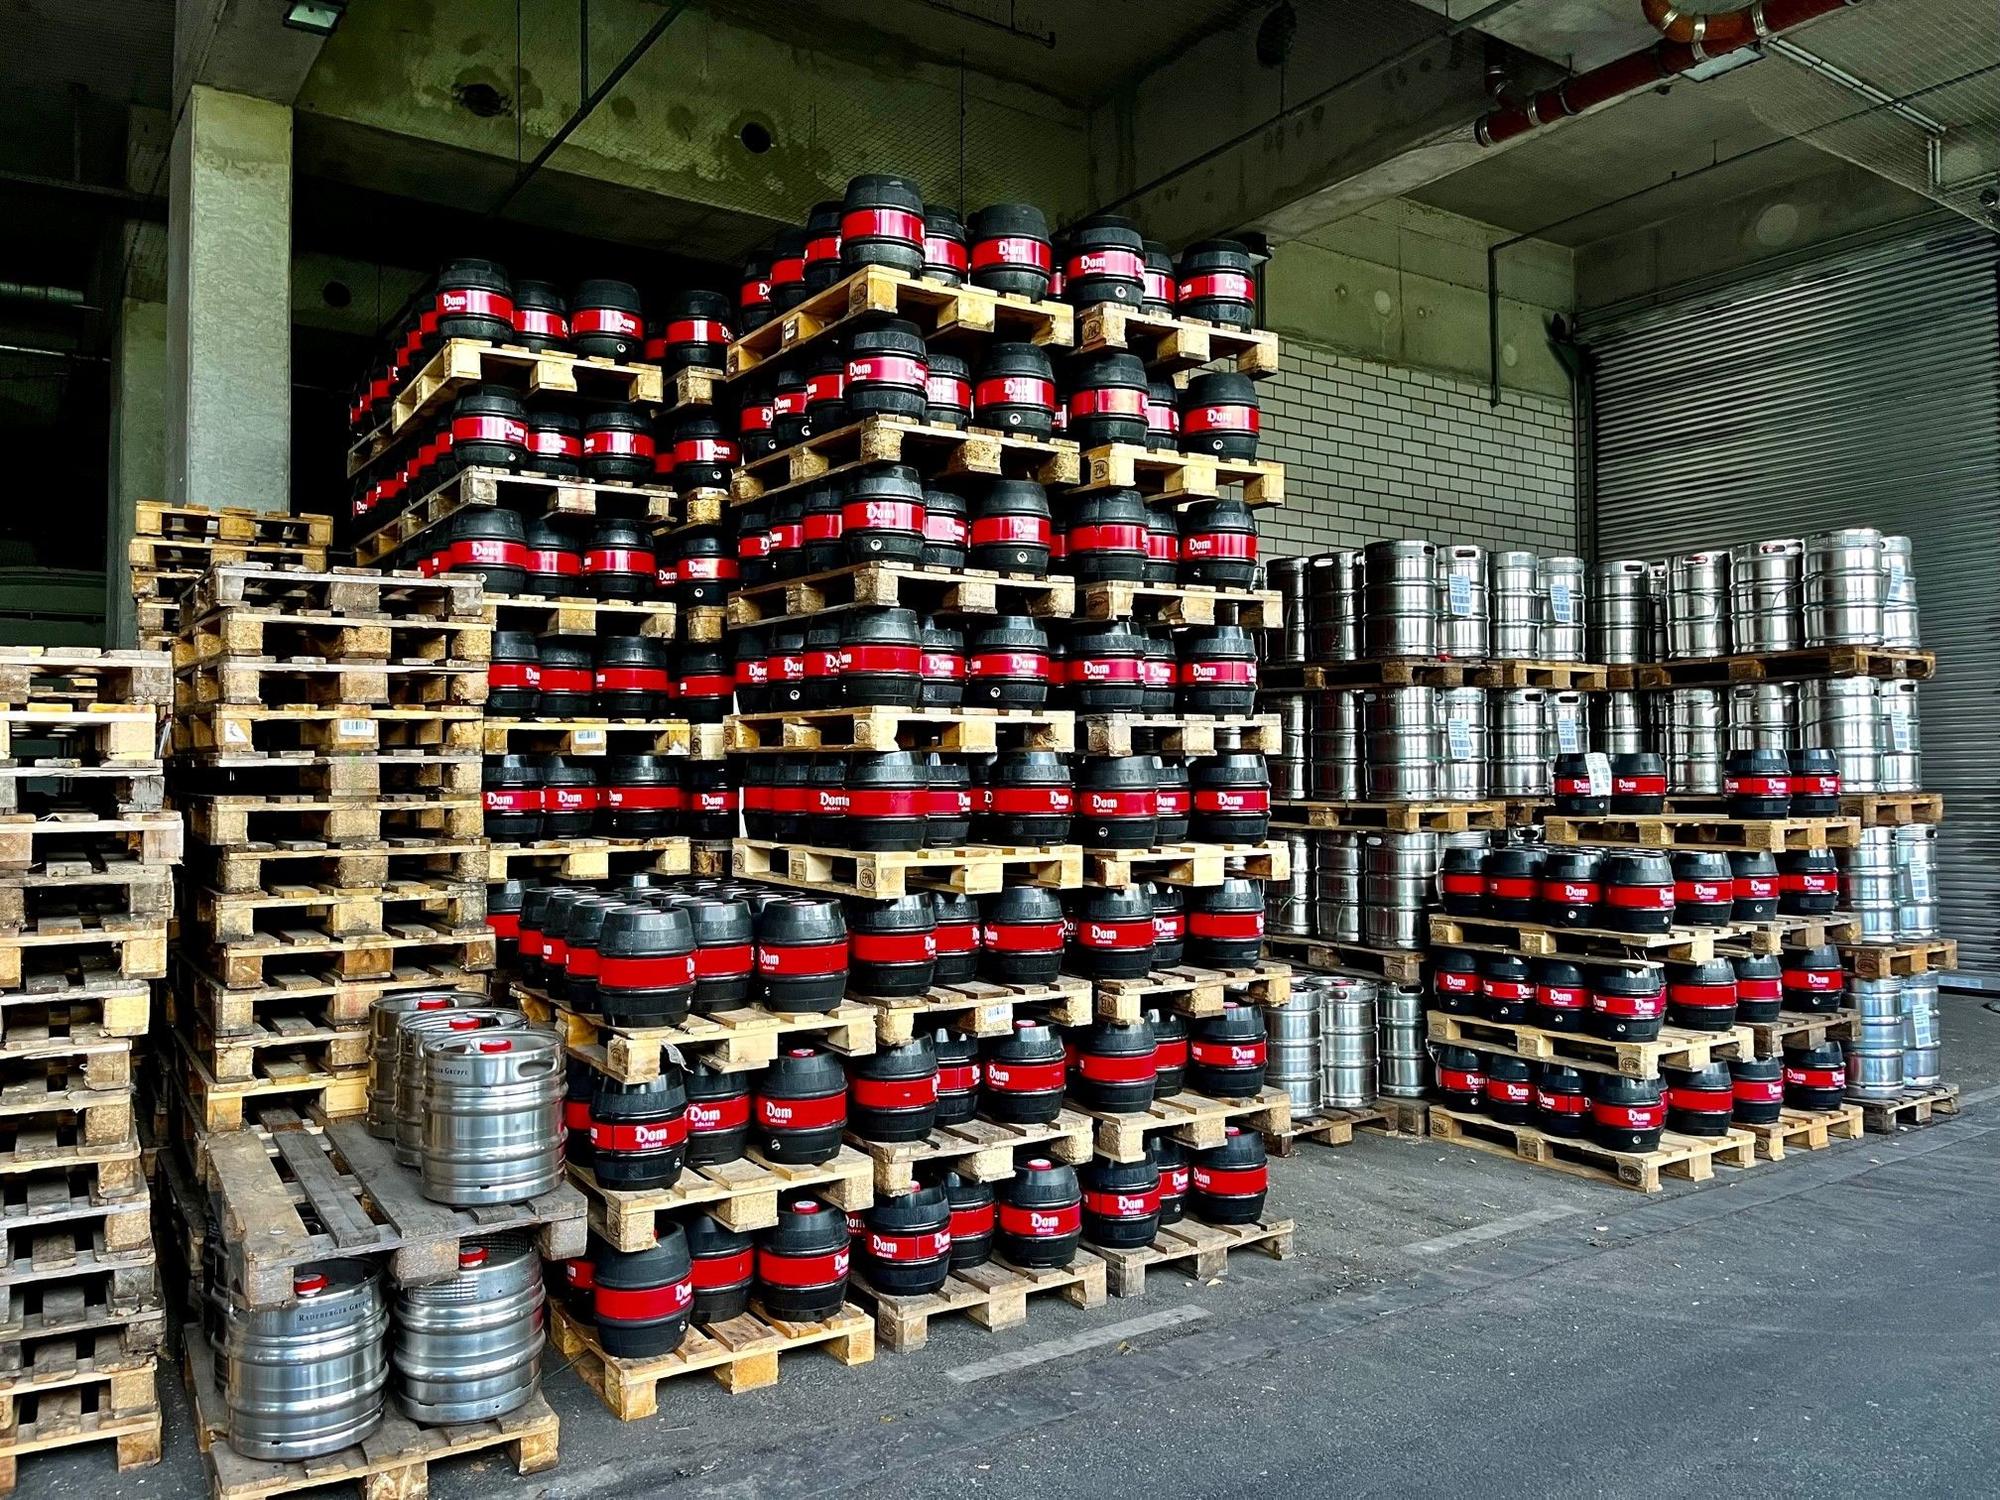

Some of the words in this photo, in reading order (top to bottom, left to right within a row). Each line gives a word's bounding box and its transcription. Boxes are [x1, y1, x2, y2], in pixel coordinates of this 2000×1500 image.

[998, 241, 1025, 257] Dom
[1081, 255, 1105, 270] Dom
[443, 294, 466, 307] Dom
[616, 314, 635, 329] Dom
[849, 362, 871, 377] Dom
[905, 364, 925, 380] Dom
[775, 398, 791, 412] Dom
[1207, 409, 1231, 423] Dom
[505, 422, 524, 438] Dom
[867, 503, 894, 520] Dom
[1014, 521, 1039, 536] Dom
[472, 543, 500, 556] Dom
[1189, 538, 1211, 551] Dom
[688, 561, 712, 573] Dom
[659, 569, 677, 580] Dom
[929, 656, 954, 671] Dom
[1011, 656, 1038, 671] Dom
[1084, 662, 1111, 677] Dom
[1150, 663, 1171, 677] Dom
[1192, 664, 1217, 678] Dom
[1619, 779, 1636, 789] Dom
[1768, 778, 1786, 790] Dom
[1819, 777, 1836, 789] Dom
[487, 791, 513, 805] Dom
[558, 791, 582, 802] Dom
[701, 793, 724, 805] Dom
[820, 792, 843, 806] Dom
[1049, 791, 1069, 805] Dom
[1092, 795, 1117, 808] Dom
[1217, 792, 1243, 806] Dom
[1751, 880, 1771, 892] Dom
[1804, 876, 1825, 887] Dom
[1565, 885, 1588, 897] Dom
[1694, 884, 1717, 896] Dom
[1156, 918, 1177, 932] Dom
[1091, 925, 1117, 940] Dom
[760, 948, 779, 965] Dom
[1447, 975, 1466, 987] Dom
[1808, 973, 1830, 984] Dom
[1550, 989, 1572, 1002] Dom
[1634, 999, 1656, 1011] Dom
[1232, 1046, 1255, 1061] Dom
[989, 1064, 1009, 1082] Dom
[1466, 1074, 1486, 1086] Dom
[1787, 1069, 1806, 1081] Dom
[1507, 1085, 1529, 1097] Dom
[1539, 1091, 1555, 1106] Dom
[690, 1106, 720, 1122] Dom
[766, 1101, 792, 1118] Dom
[1628, 1109, 1651, 1121] Dom
[635, 1126, 667, 1143] Dom
[1194, 1167, 1210, 1185] Dom
[1118, 1195, 1144, 1211] Dom
[1031, 1212, 1059, 1228] Dom
[873, 1234, 897, 1254] Dom
